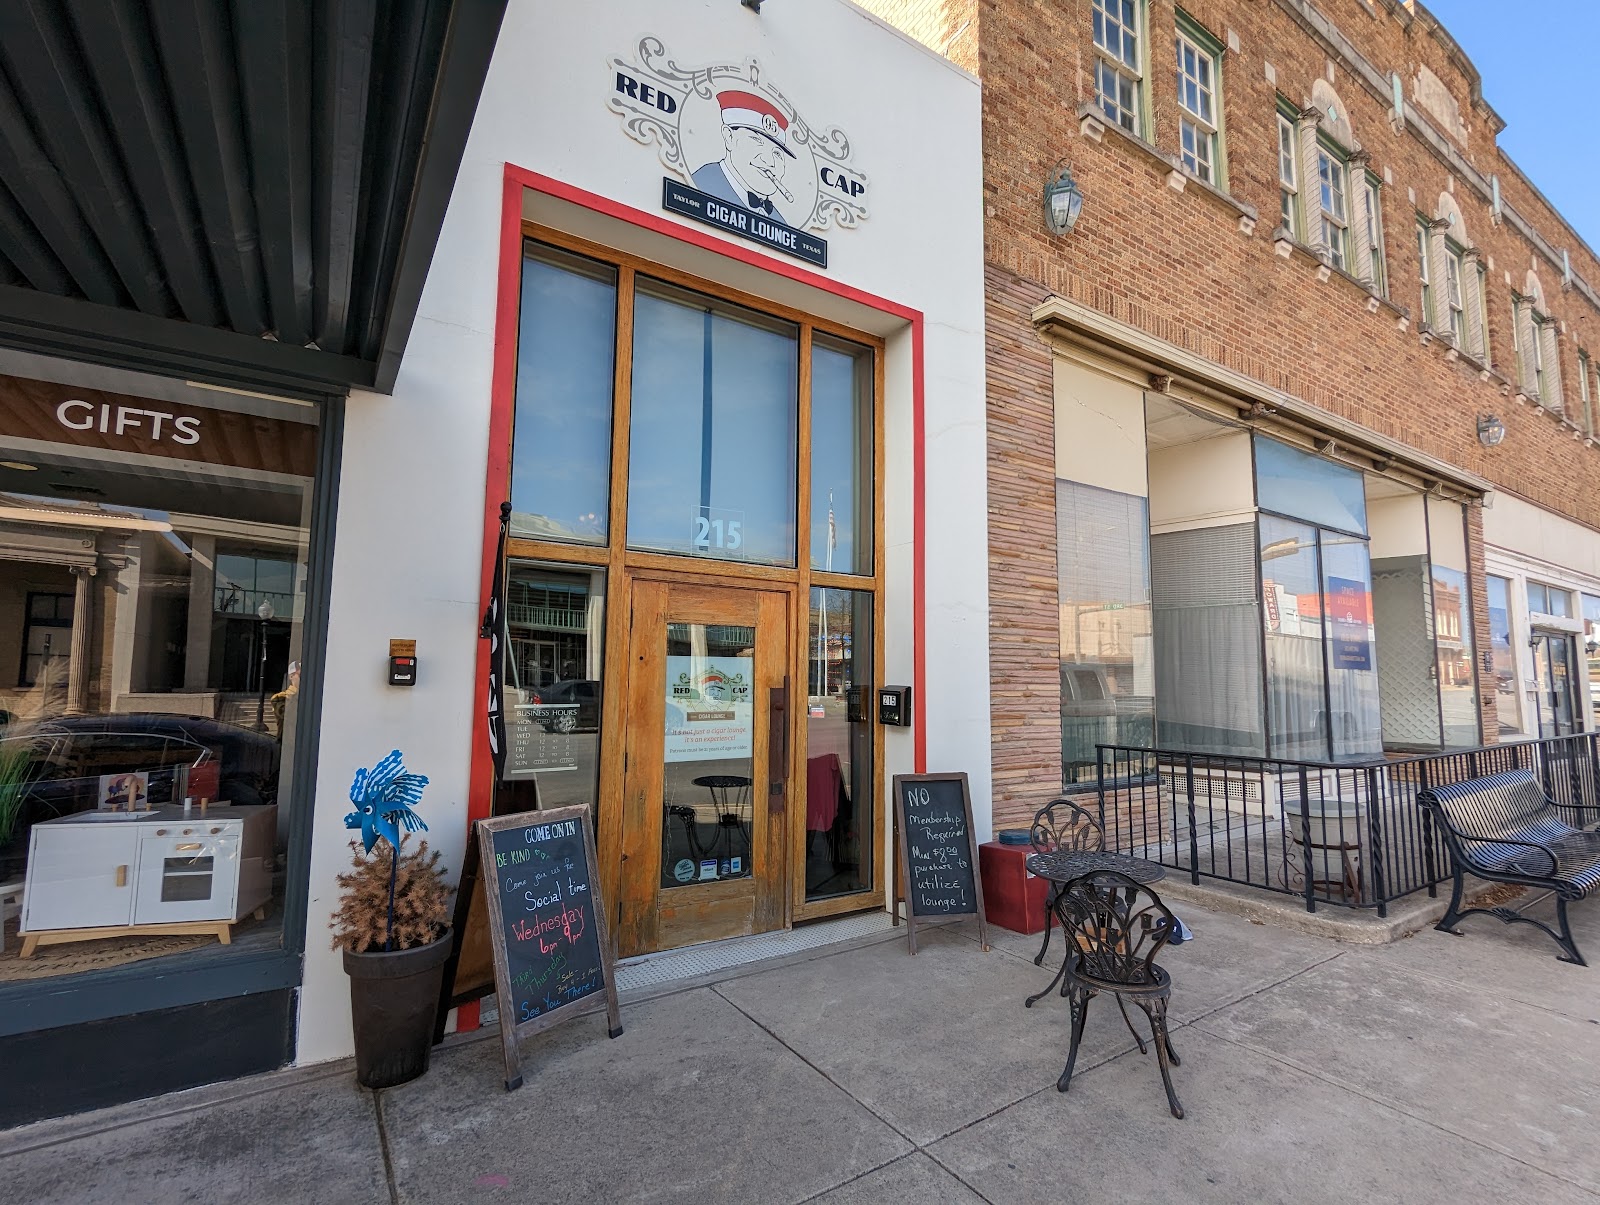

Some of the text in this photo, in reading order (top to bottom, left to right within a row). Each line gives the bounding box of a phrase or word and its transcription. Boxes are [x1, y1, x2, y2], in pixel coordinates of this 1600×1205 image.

[615, 71, 677, 115] RED
[764, 116, 778, 134] 95
[820, 166, 865, 198] CAP
[672, 192, 701, 209] TAYLOR
[706, 201, 798, 250] CIGAR LOUNGE
[802, 242, 822, 255] TEXAS
[56, 399, 201, 445] GIFTS
[694, 516, 742, 550] 215
[883, 695, 896, 706] 215
[516, 708, 578, 717] BUSINESS HOURS
[711, 727, 726, 735] cigar
[908, 787, 930, 807] NO
[909, 811, 962, 827] Membership
[524, 820, 576, 844] COME ON IN
[920, 824, 965, 844] Required
[496, 848, 531, 868] BE KIND
[914, 857, 968, 878] purchase to
[505, 857, 574, 893] Come join us for
[917, 874, 961, 890] utilize
[524, 876, 588, 912] Social time
[511, 902, 585, 942] Wednesday
[524, 951, 567, 995] Thursday
[521, 1001, 541, 1021] See
[544, 991, 562, 1011] You
